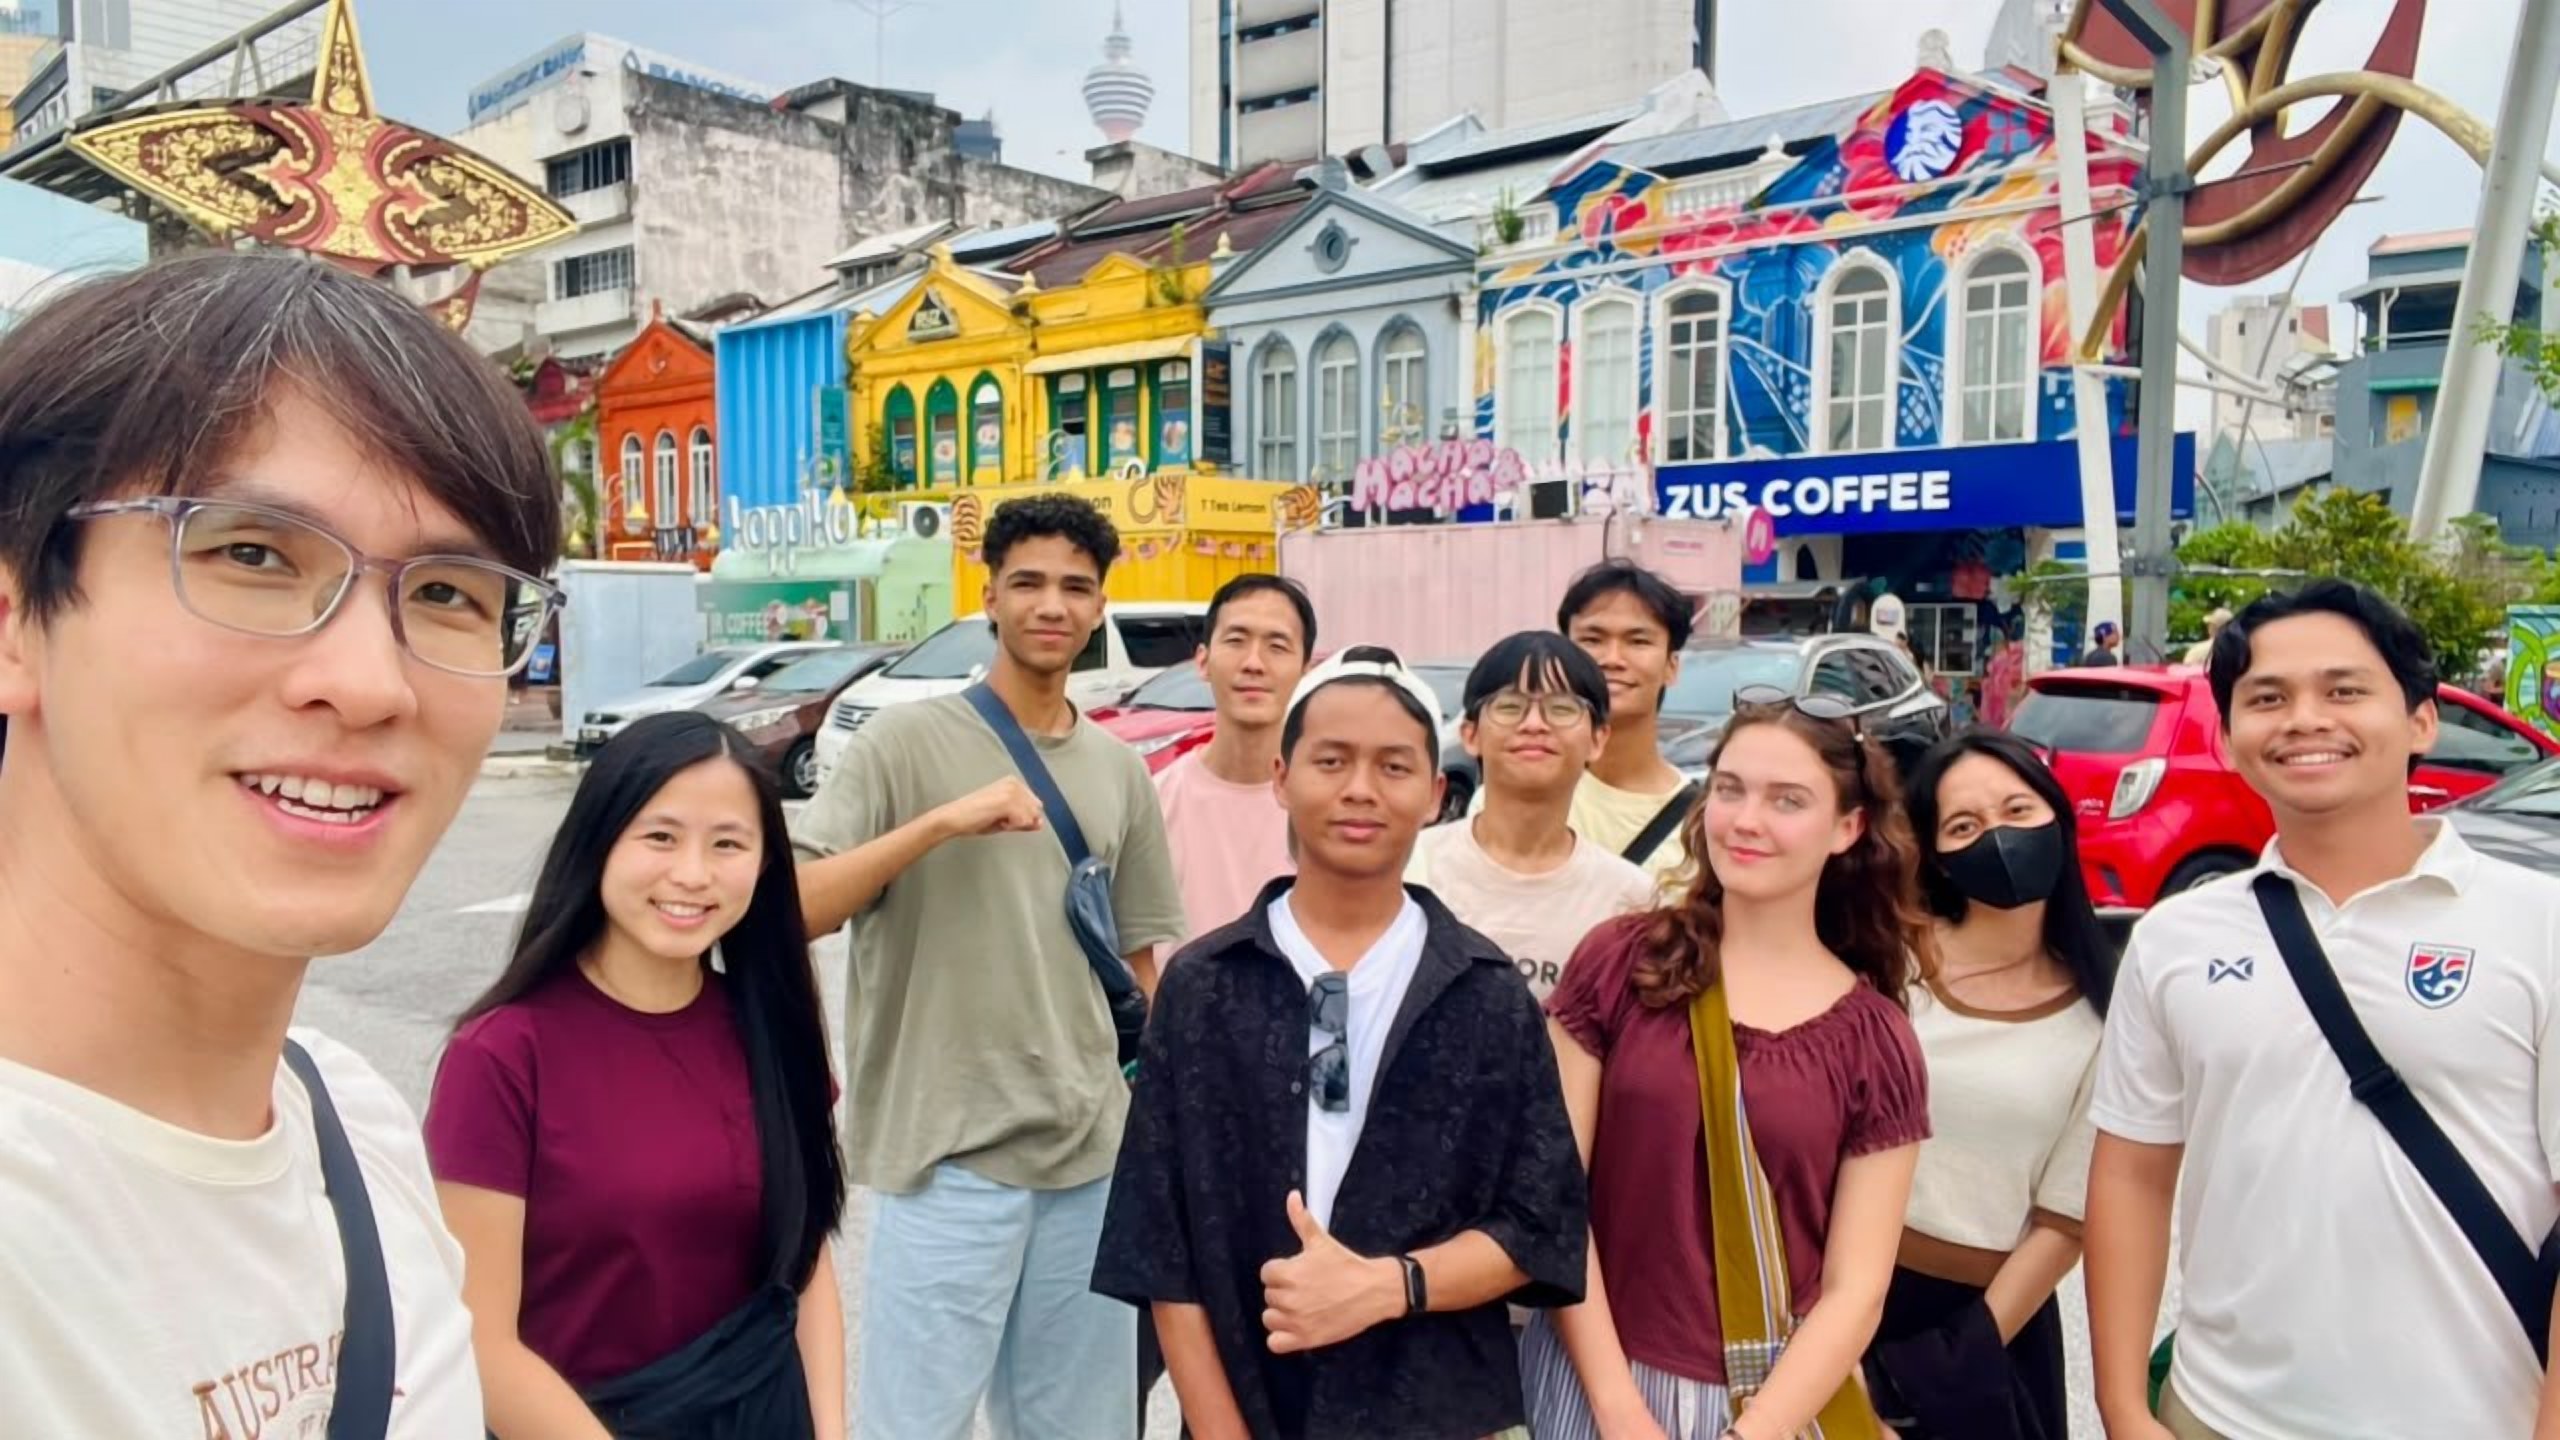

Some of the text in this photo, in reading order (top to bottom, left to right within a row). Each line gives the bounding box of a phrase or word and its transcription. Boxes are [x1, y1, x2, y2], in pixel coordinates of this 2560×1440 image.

[1665, 482, 1748, 520] ZUS
[1761, 470, 1951, 517] COFFEE
[192, 1330, 345, 1440] AUSTRA
